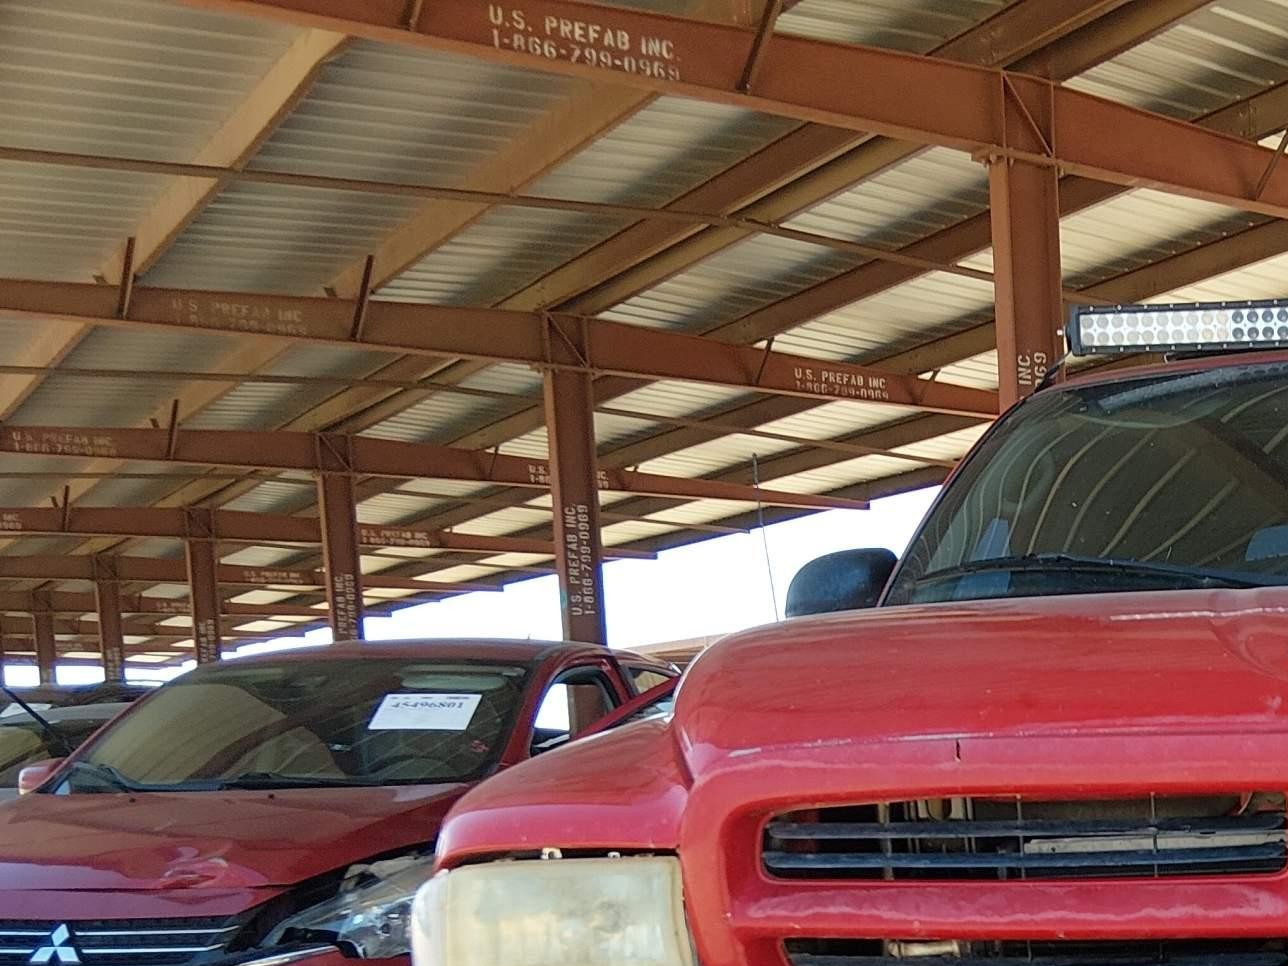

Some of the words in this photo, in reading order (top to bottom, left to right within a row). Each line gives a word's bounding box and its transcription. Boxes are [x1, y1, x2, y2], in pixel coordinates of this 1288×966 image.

[489, 4, 533, 32] U.S.
[545, 16, 631, 50] PREFAB
[641, 36, 681, 62] INC.
[794, 368, 817, 381] U.S.
[821, 371, 864, 387] PREFAB
[567, 534, 580, 584] PREFAB
[571, 592, 583, 616] U.S.
